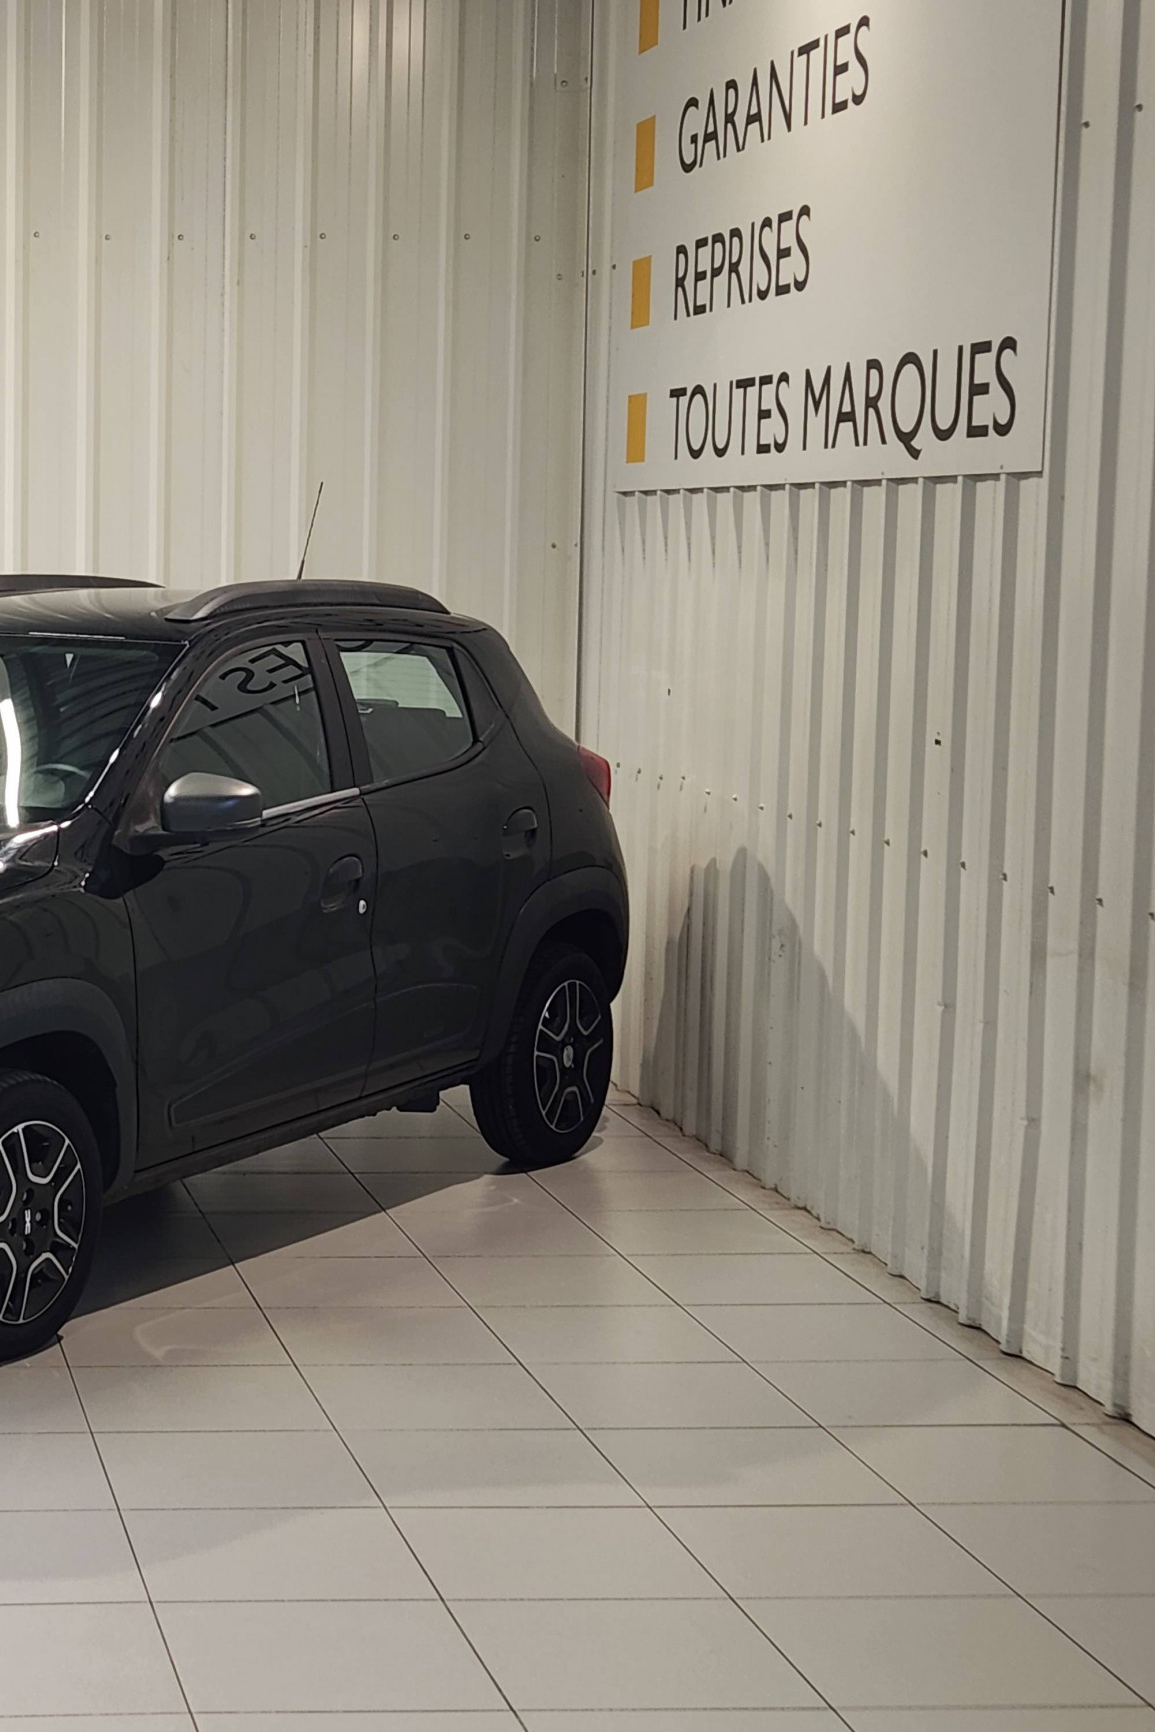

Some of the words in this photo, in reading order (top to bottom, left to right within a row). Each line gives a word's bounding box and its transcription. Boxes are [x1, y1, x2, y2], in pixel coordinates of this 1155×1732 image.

[678, 15, 871, 174] GARANTIES
[673, 204, 812, 321] REPRISES
[668, 371, 791, 461] TOUTES
[802, 335, 1018, 461] MARQUES
